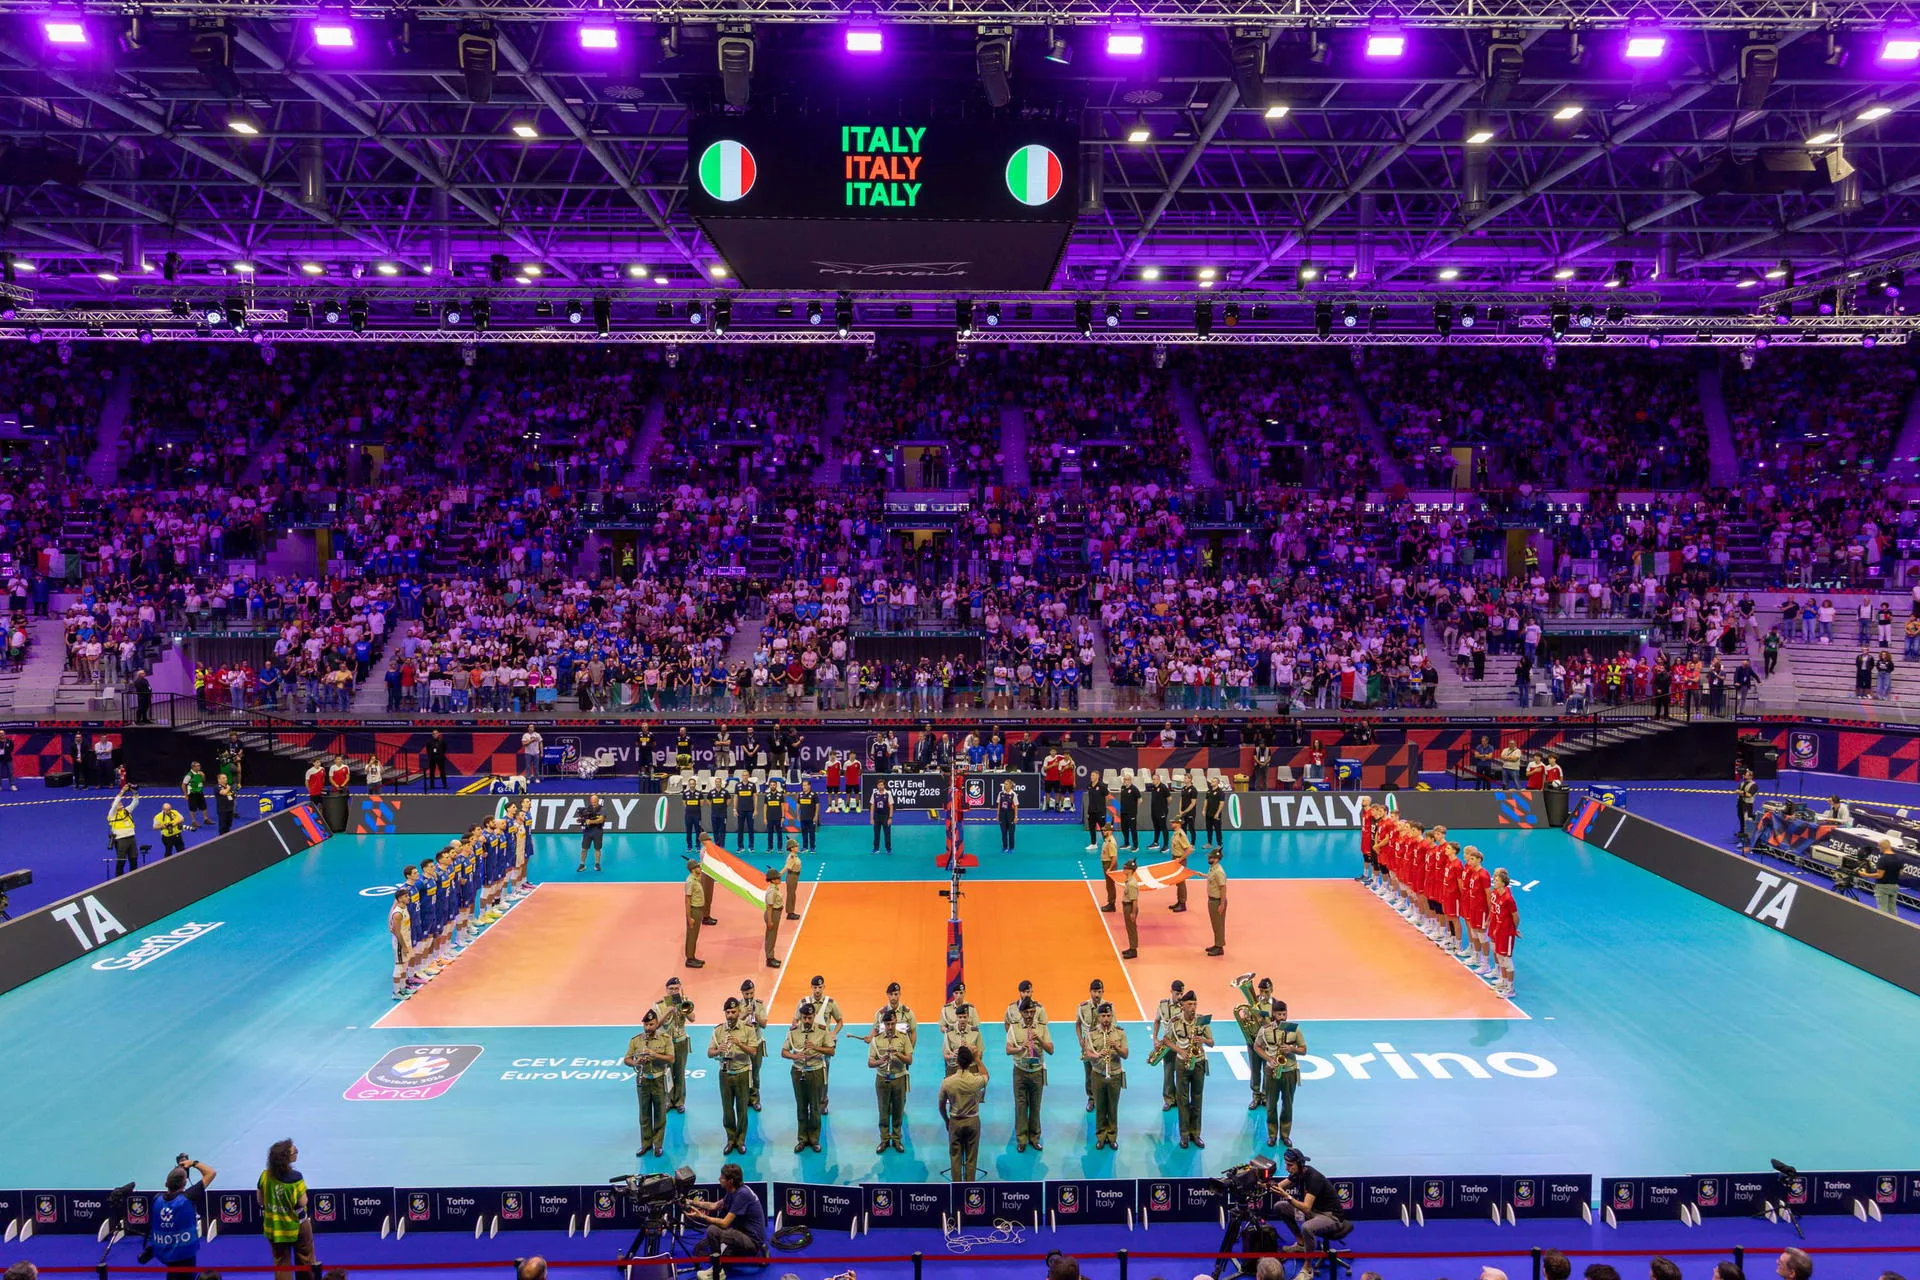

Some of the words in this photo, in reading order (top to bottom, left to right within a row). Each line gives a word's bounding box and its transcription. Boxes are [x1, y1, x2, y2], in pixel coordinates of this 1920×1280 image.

[842, 126, 926, 153] ITALY
[845, 156, 922, 180] ITALY
[846, 183, 922, 206] ITALY
[888, 780, 905, 788] CEV
[907, 780, 925, 788] Enel
[920, 788, 940, 796] 2026
[897, 797, 916, 805] Men
[1260, 796, 1364, 827] ITALY
[1744, 871, 1798, 929] TA
[51, 894, 127, 950] TA
[511, 1058, 567, 1067] CEV
[569, 1058, 625, 1067] Enel
[500, 1071, 637, 1081] EuroVolley
[357, 1088, 432, 1099] enel
[1461, 1185, 1488, 1193] Torino
[1552, 1184, 1578, 1192] Torino
[1735, 1183, 1761, 1191] Torino
[1824, 1181, 1851, 1189] Torino
[1096, 1190, 1123, 1199] Torino
[1370, 1186, 1397, 1194] Torino
[1651, 1186, 1677, 1194] Torino
[1824, 1190, 1844, 1199] Italy
[447, 1197, 475, 1205] Torino
[540, 1196, 567, 1204] Torino
[823, 1195, 850, 1206] Torino
[910, 1193, 937, 1202] Torino
[1002, 1192, 1029, 1201] Torino
[1370, 1195, 1390, 1204] Italy
[1461, 1194, 1481, 1203] Italy
[1552, 1193, 1572, 1202] Italy
[1651, 1195, 1671, 1204] Italy
[1735, 1192, 1755, 1201] Italy
[73, 1200, 101, 1208] Torino
[353, 1198, 381, 1206] Torino
[1002, 1202, 1022, 1211] Italy
[1096, 1200, 1116, 1209] Italy
[1188, 1198, 1208, 1207] Italy
[353, 1207, 373, 1216] Italy
[447, 1206, 467, 1215] Italy
[540, 1205, 560, 1214] Italy
[823, 1206, 843, 1216] Italy
[910, 1203, 930, 1212] Italy
[73, 1209, 93, 1218] Italy
